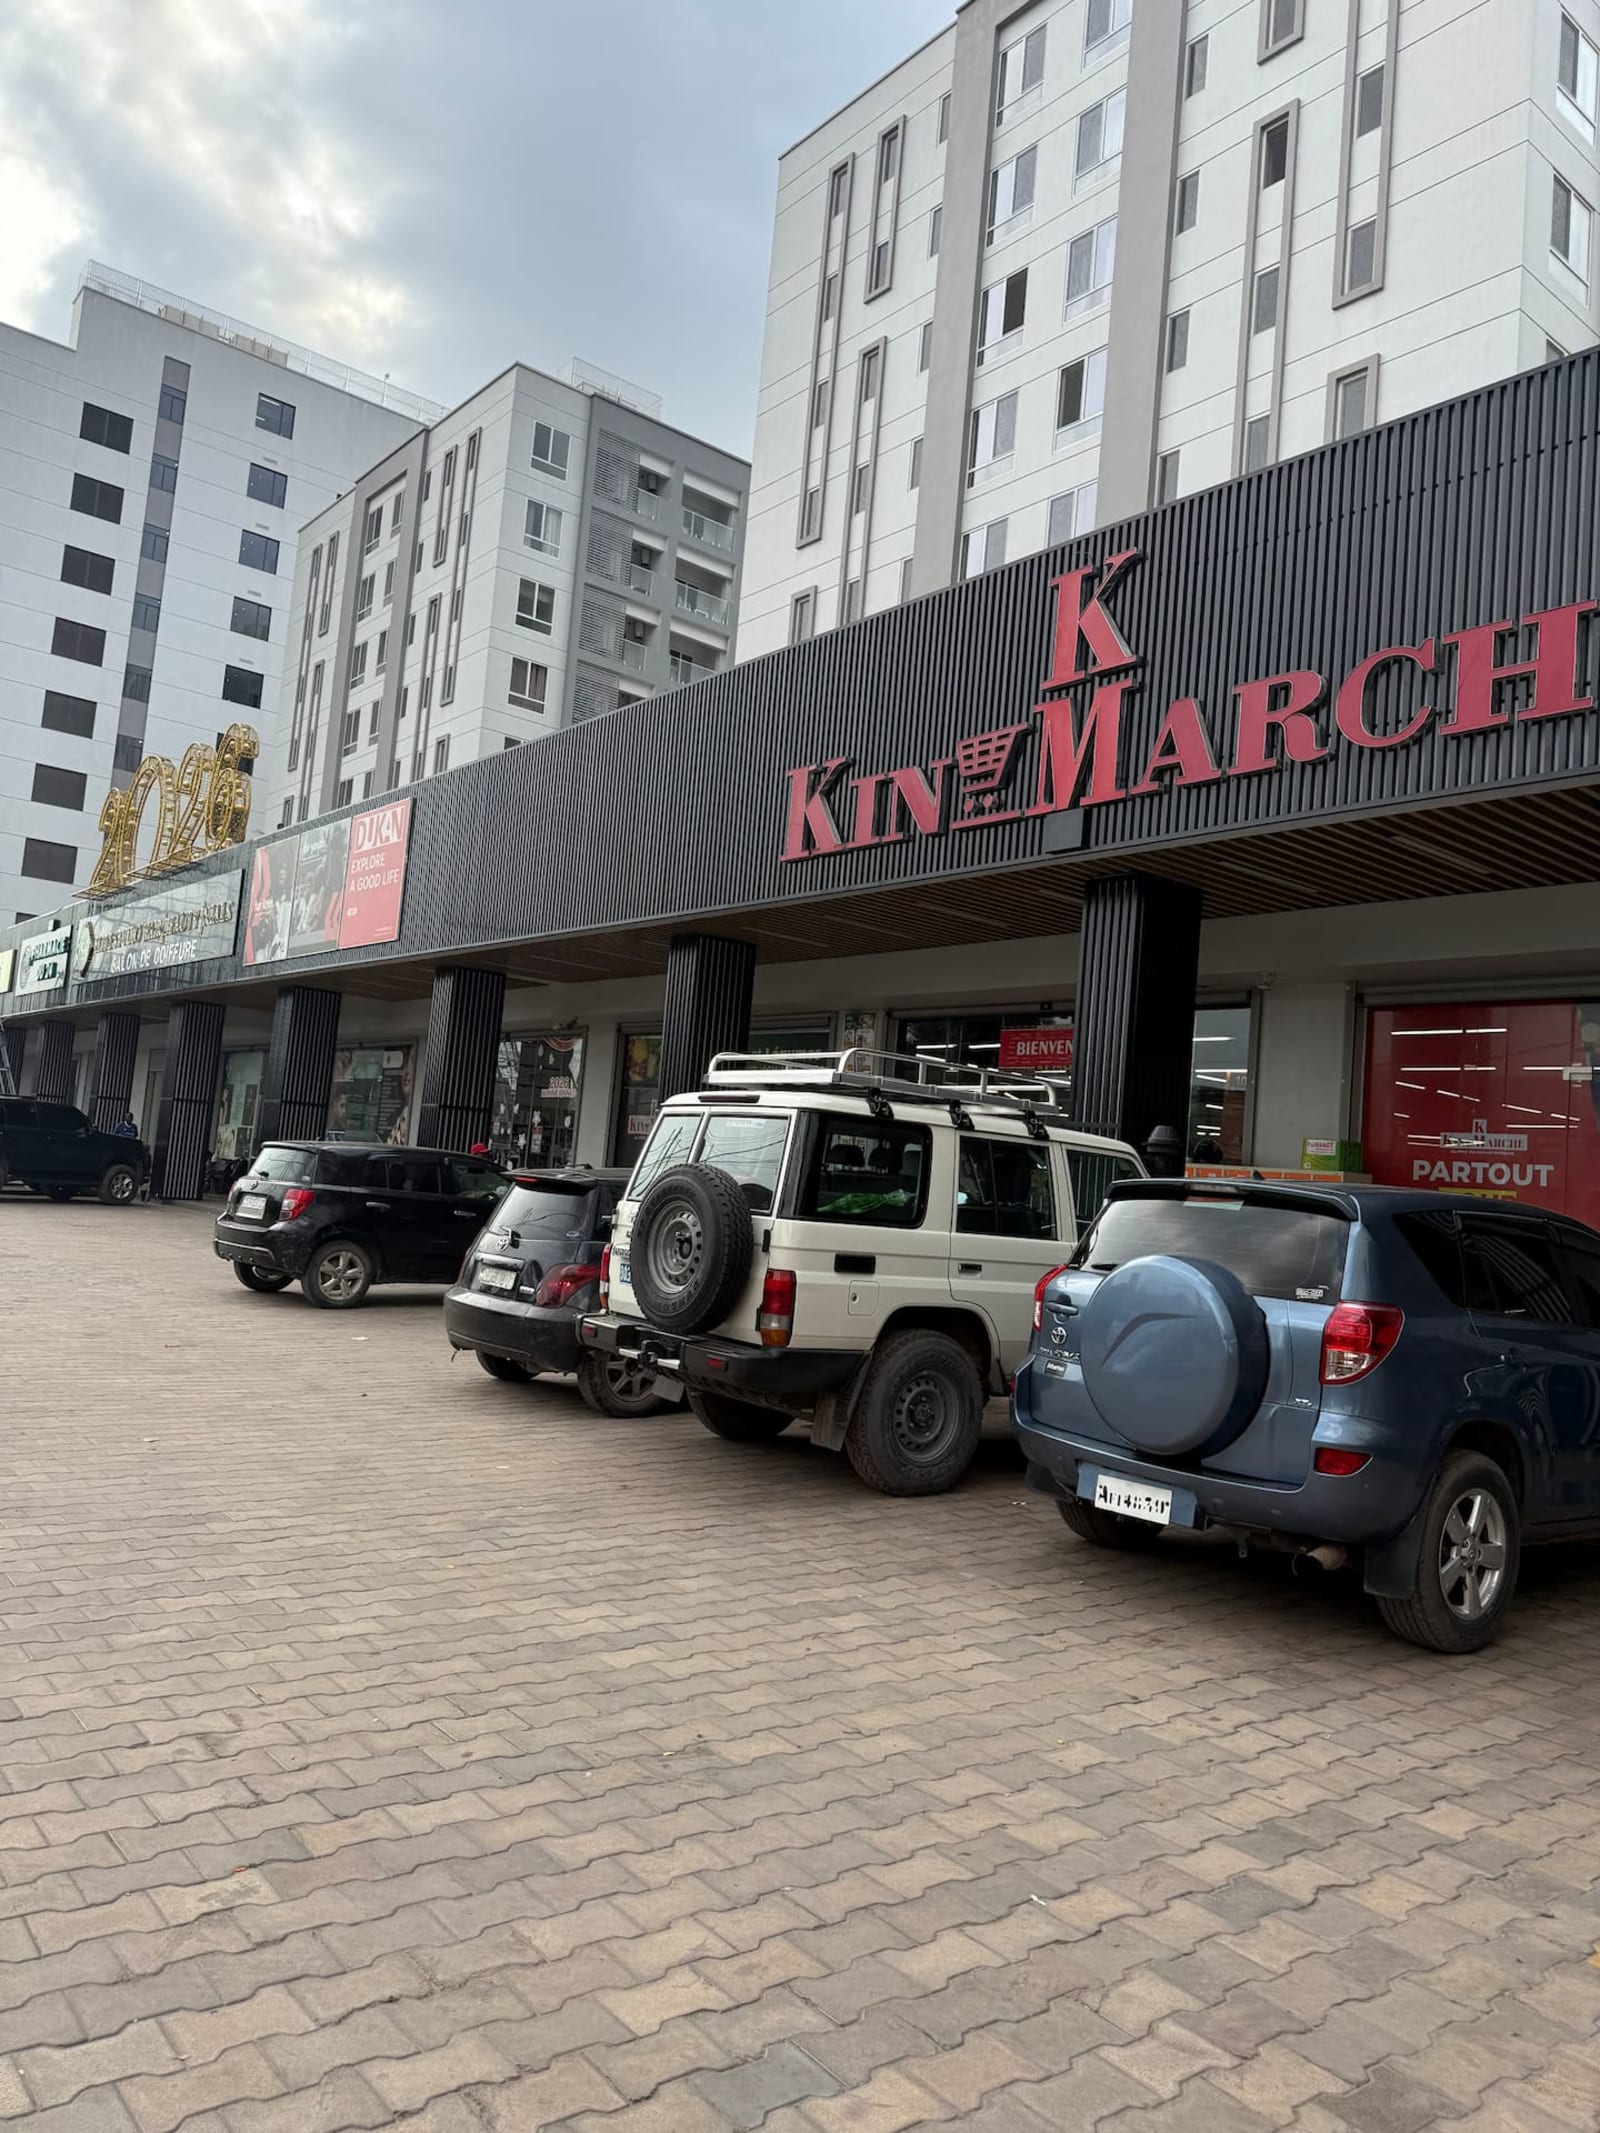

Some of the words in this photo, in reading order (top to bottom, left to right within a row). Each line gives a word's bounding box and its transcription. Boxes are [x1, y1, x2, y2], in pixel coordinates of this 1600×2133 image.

[1042, 546, 1140, 691] K
[90, 722, 260, 888] 2026
[780, 756, 957, 862] KIN
[355, 806, 406, 852] DUKAN
[349, 879, 356, 893] A
[356, 873, 381, 892] GOOD
[382, 868, 400, 887] LIFE
[351, 852, 386, 874] EXPLORE
[110, 950, 138, 974] SALON
[139, 949, 151, 967] DE
[153, 939, 198, 964] COIFFURE
[1412, 1159, 1555, 1188] PARTOUT
